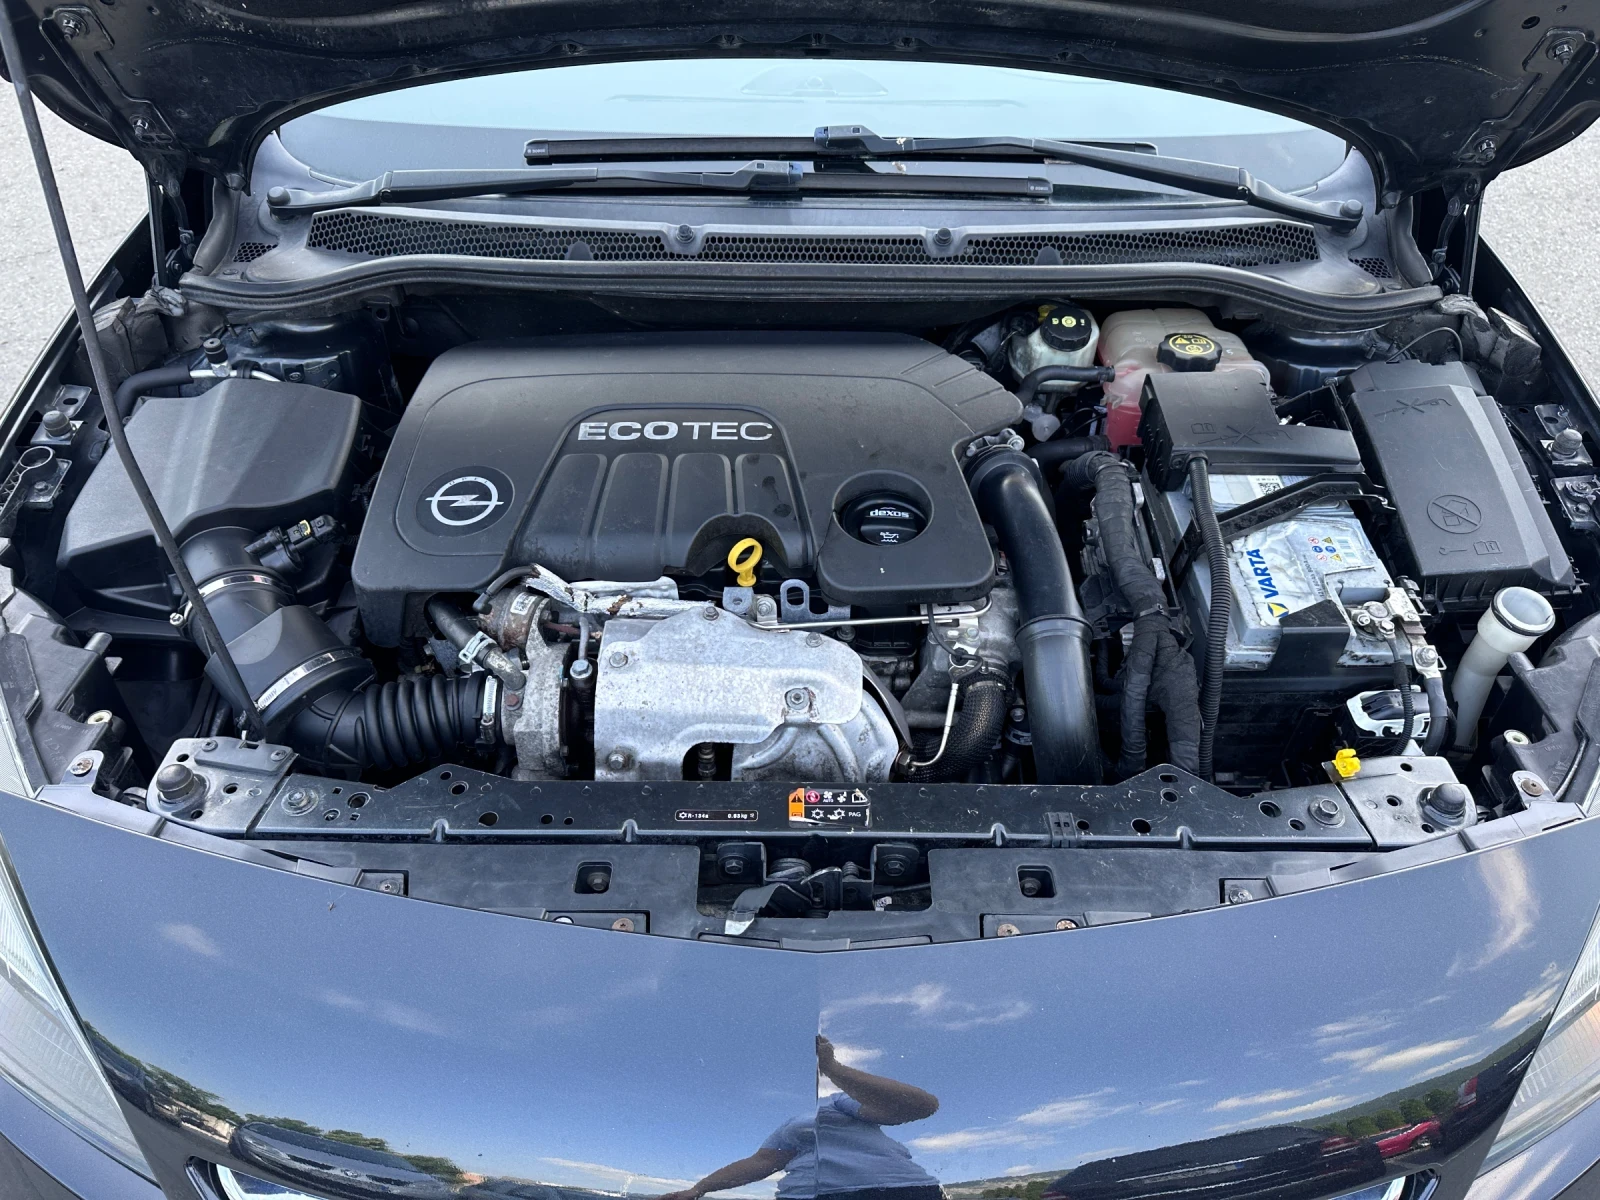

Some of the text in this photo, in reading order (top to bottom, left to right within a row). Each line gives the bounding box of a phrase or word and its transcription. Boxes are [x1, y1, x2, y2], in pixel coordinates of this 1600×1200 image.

[577, 420, 774, 442] ECOTEC
[869, 508, 910, 518] dexos
[1246, 548, 1280, 599] VARTA
